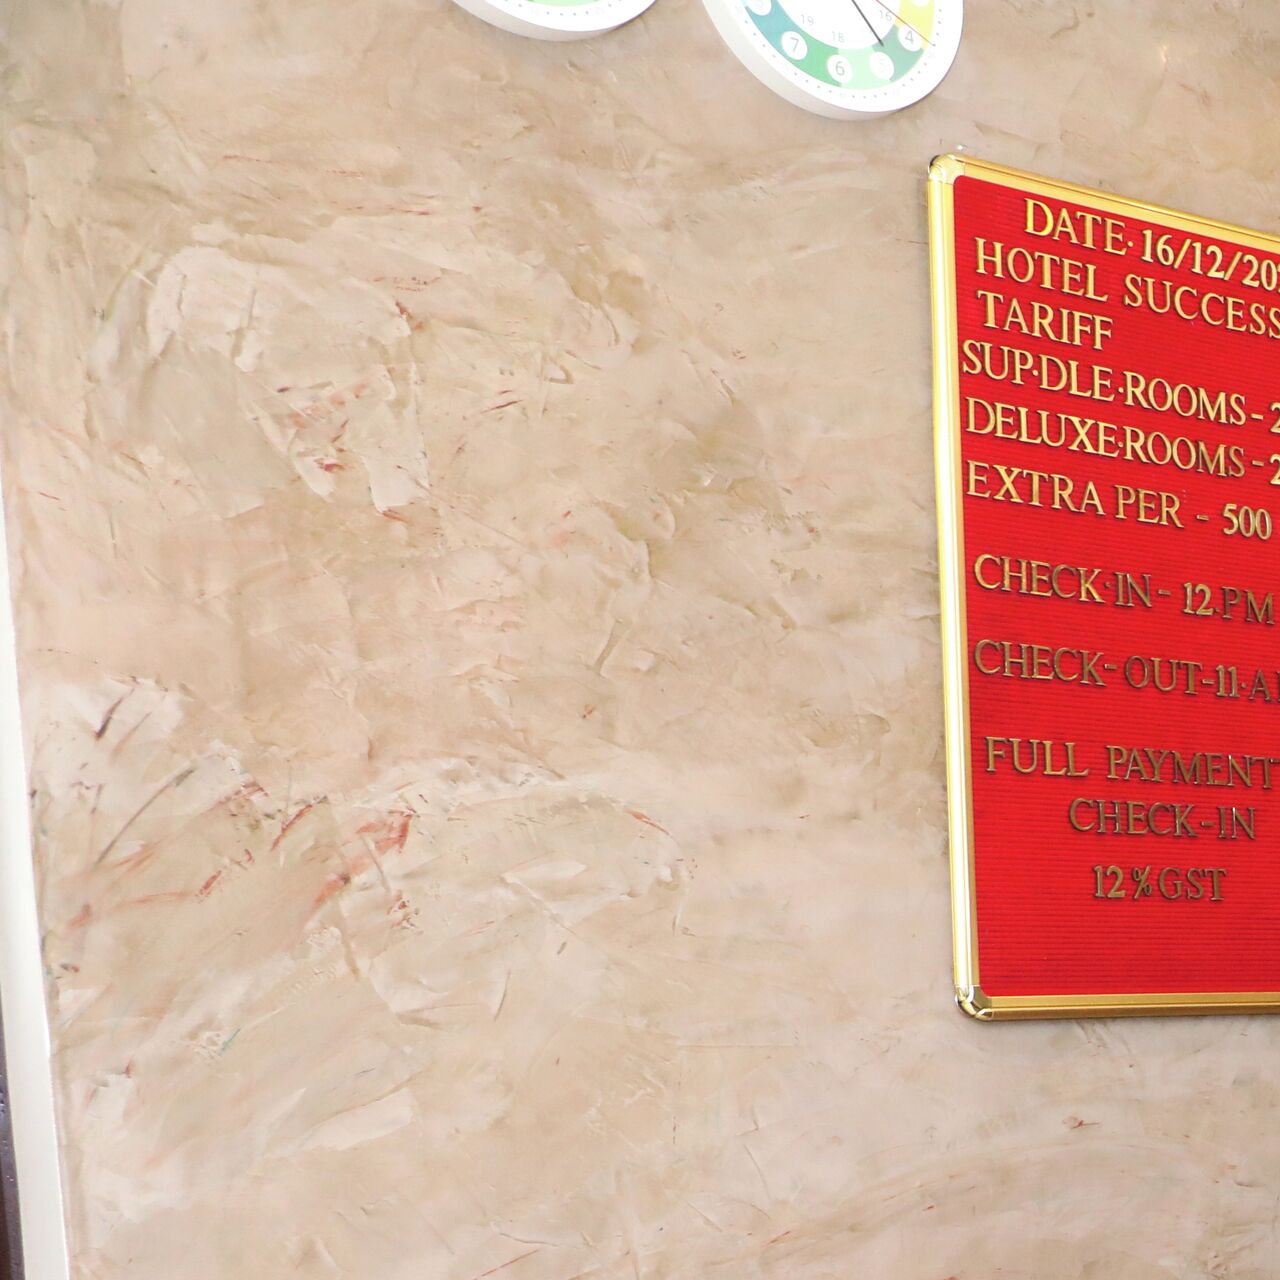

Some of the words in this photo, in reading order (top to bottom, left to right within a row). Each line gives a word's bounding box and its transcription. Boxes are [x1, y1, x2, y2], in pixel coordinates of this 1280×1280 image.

[975, 237, 1108, 303] HOTEL
[977, 290, 1113, 350] TARIFF
[966, 460, 1106, 515] EXTRA
[1114, 484, 1185, 528] PER
[1222, 503, 1273, 541] 500
[984, 735, 1089, 778] FULL
